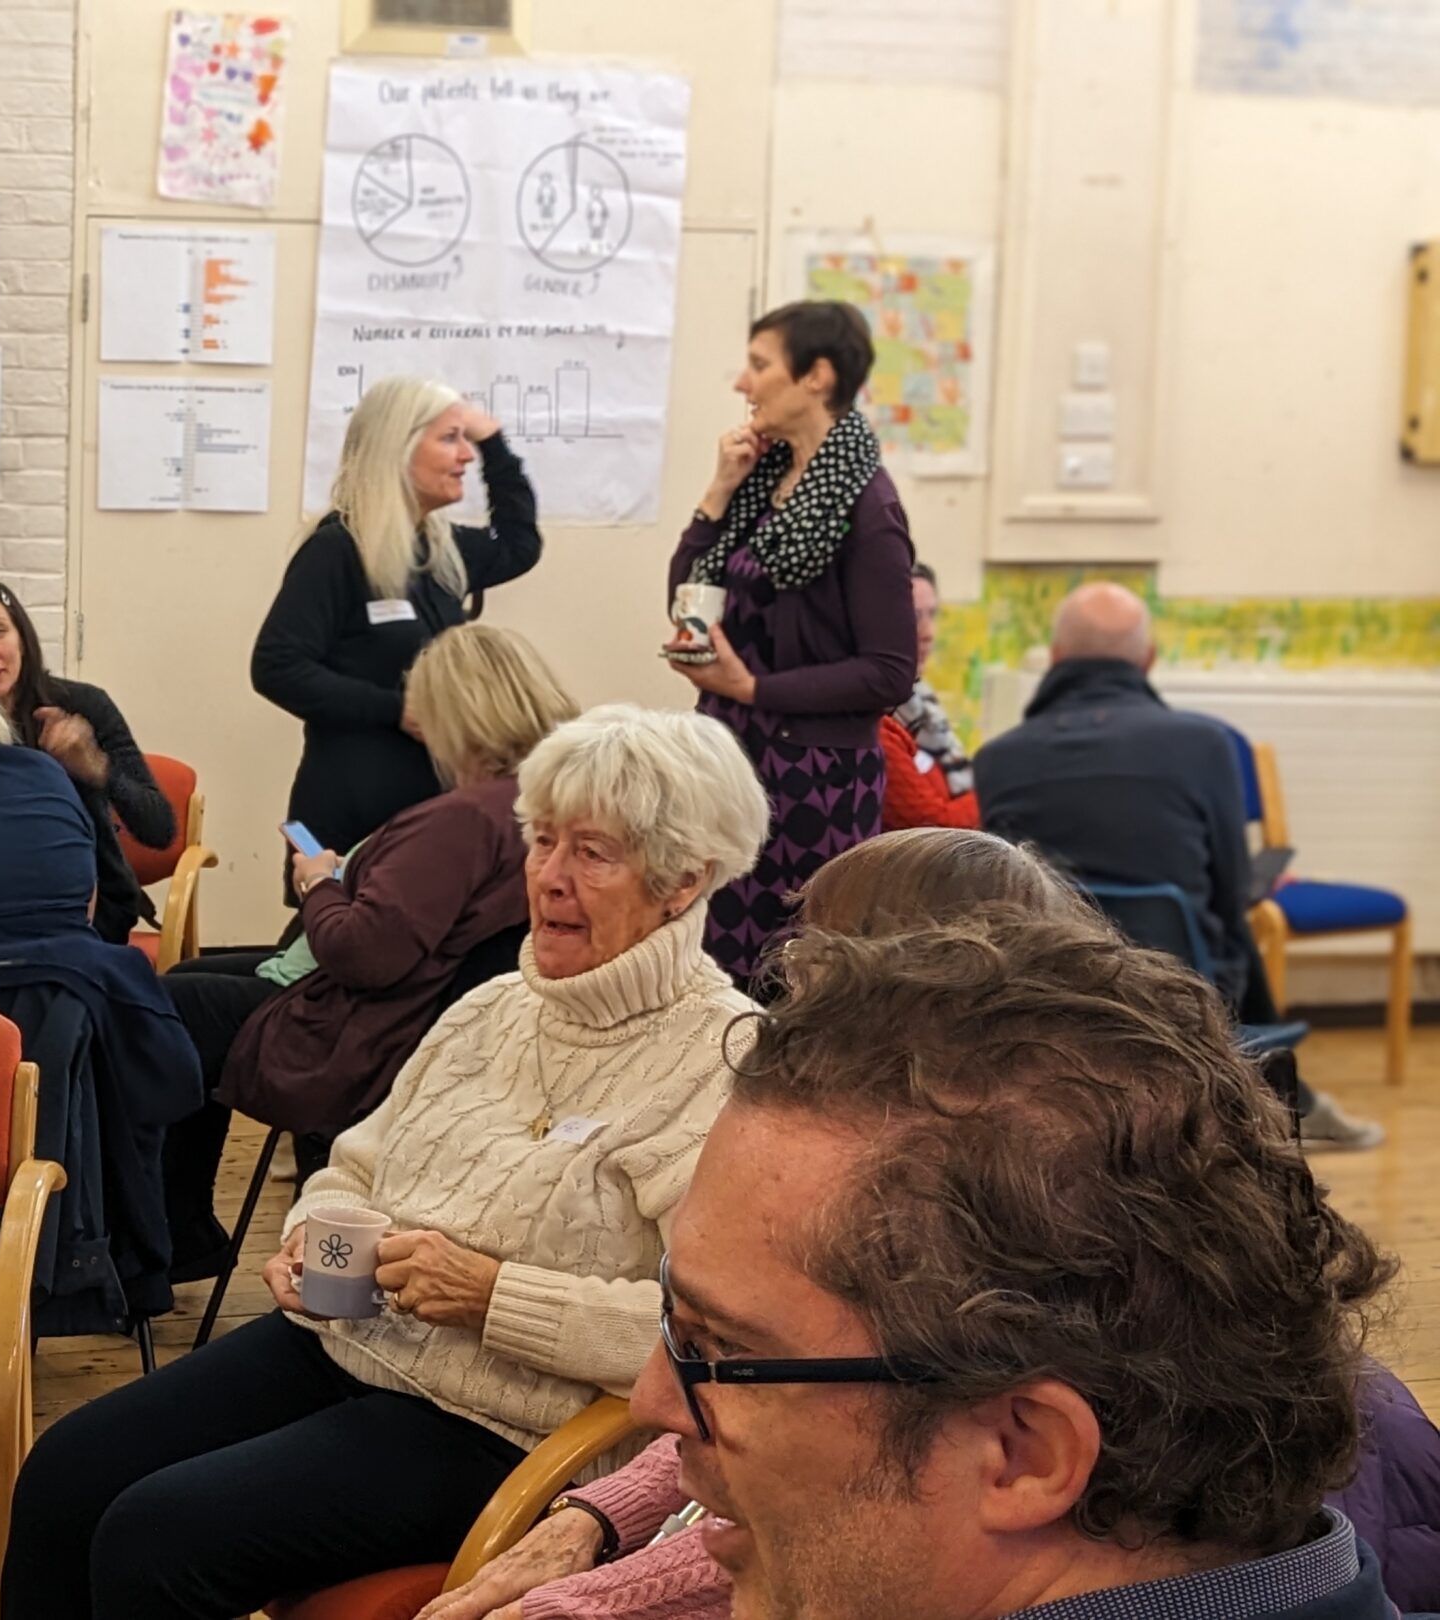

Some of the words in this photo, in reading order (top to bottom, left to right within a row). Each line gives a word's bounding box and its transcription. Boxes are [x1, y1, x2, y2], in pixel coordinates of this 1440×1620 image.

[378, 79, 409, 104] Our
[523, 272, 584, 298] GENDER
[732, 1368, 754, 1376] HUGO
